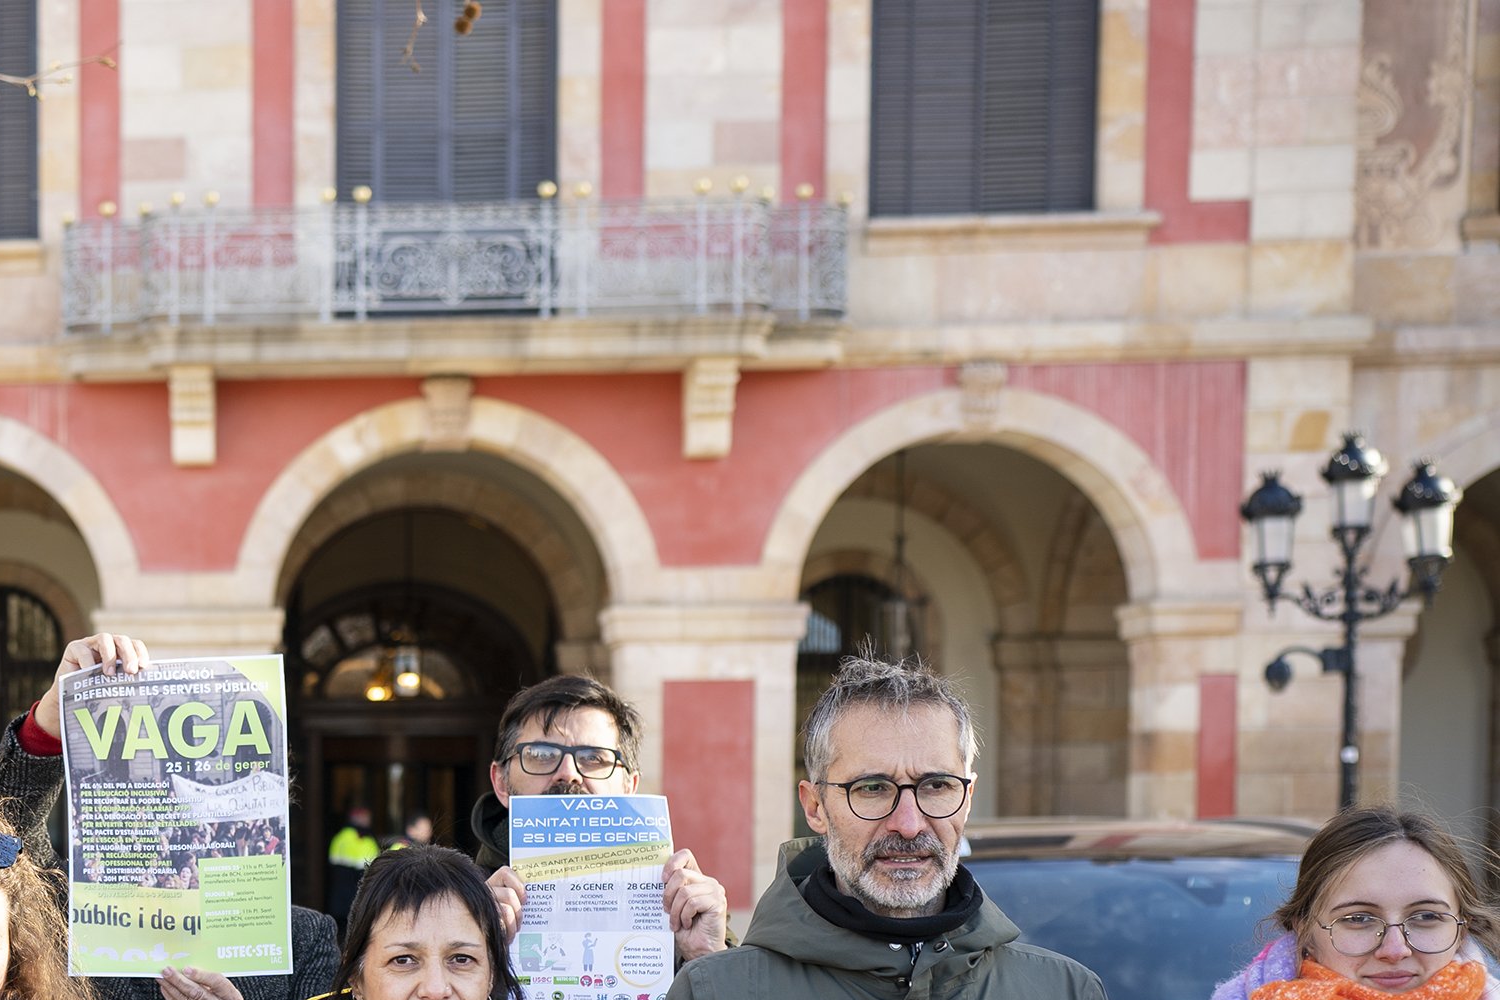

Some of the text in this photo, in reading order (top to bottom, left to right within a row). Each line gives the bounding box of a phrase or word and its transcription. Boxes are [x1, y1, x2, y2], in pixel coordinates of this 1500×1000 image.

[74, 668, 214, 690] DEFENSEM L'EDUCACIÓ!
[74, 680, 268, 701] DEFENSEM ELS SERVEIS PÚBLICS!
[74, 701, 272, 760] VAGA
[166, 760, 270, 773] 25 i 26 de gener
[561, 799, 618, 810] VAGA
[513, 815, 668, 827] SANITAT I EDUCACIÓ
[523, 832, 660, 842] 25 I 26 DE GENER
[525, 884, 555, 892] GENER
[583, 883, 613, 891] GENER
[139, 907, 143, 928] i
[151, 909, 175, 930] de
